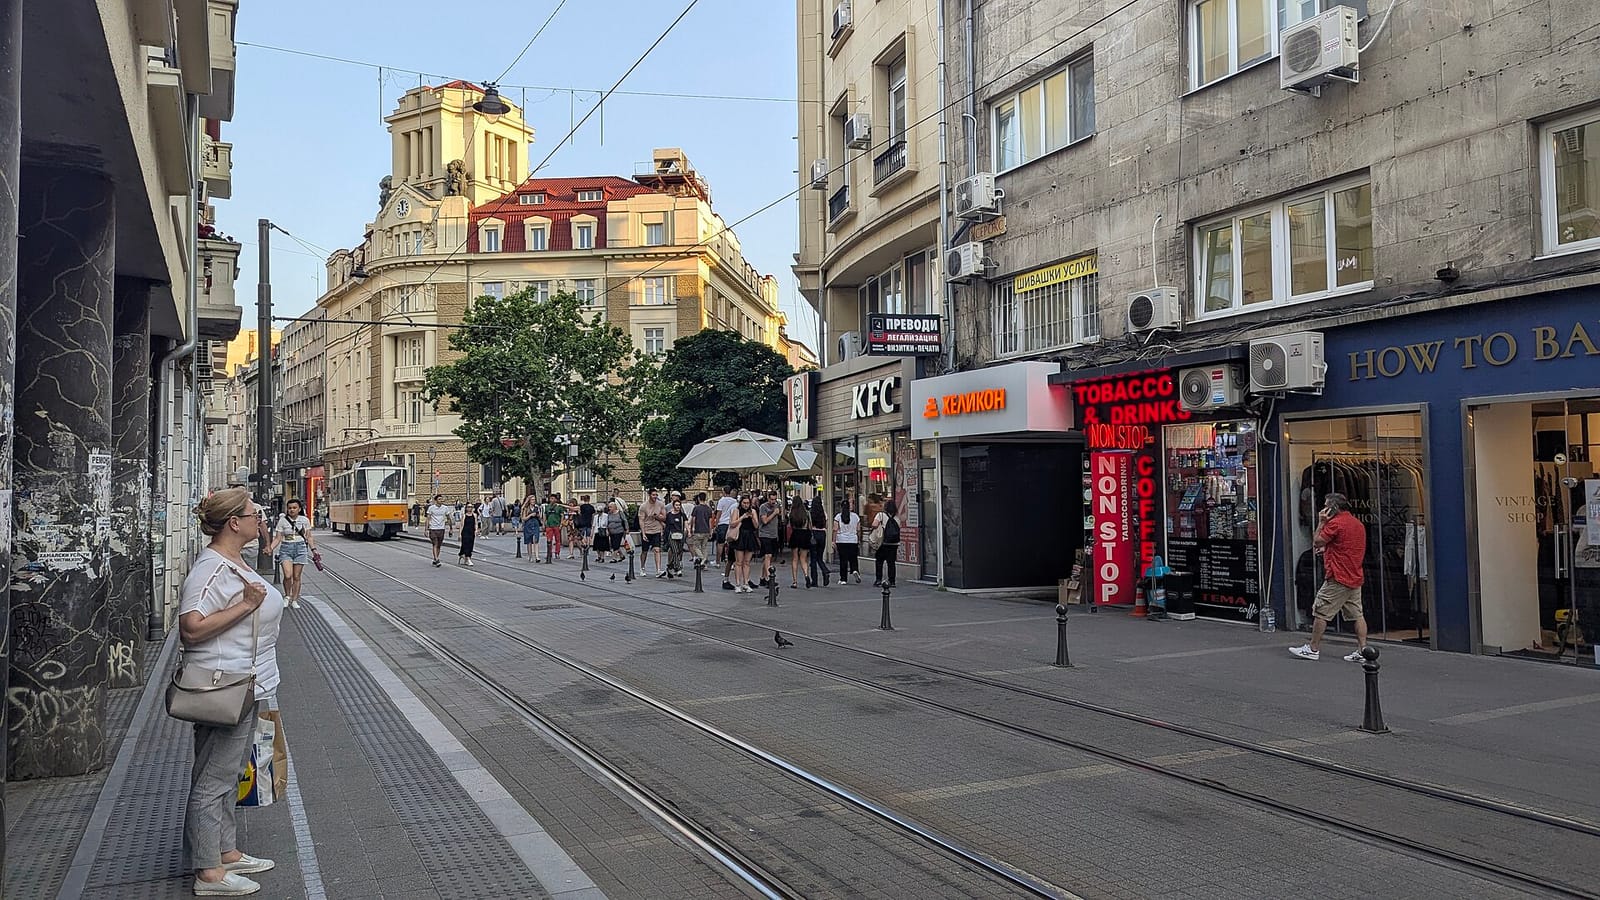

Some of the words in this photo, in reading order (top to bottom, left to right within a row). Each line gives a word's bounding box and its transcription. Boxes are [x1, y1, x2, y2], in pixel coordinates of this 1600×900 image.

[1017, 269, 1061, 290] ШИВАШКИ
[1063, 256, 1097, 277] УСЛУГИ
[886, 318, 938, 332] ПРЕВОДИ
[887, 334, 938, 342] ЛЕГАЛИЗАЦИЯ
[1348, 340, 1444, 382] HOW
[1454, 332, 1517, 369] TO
[1530, 321, 1600, 362] BA
[850, 376, 895, 420] KFC
[941, 388, 1006, 417] ХЕЛИКОН
[1073, 375, 1174, 405] TOBACCO
[1083, 406, 1099, 424] &
[1090, 423, 1115, 448] NON
[1119, 424, 1149, 449] STOP
[1097, 456, 1117, 514] NON
[1495, 495, 1556, 508] VINTAGE
[1507, 511, 1544, 524] SHOP
[1099, 521, 1120, 602] STOP
